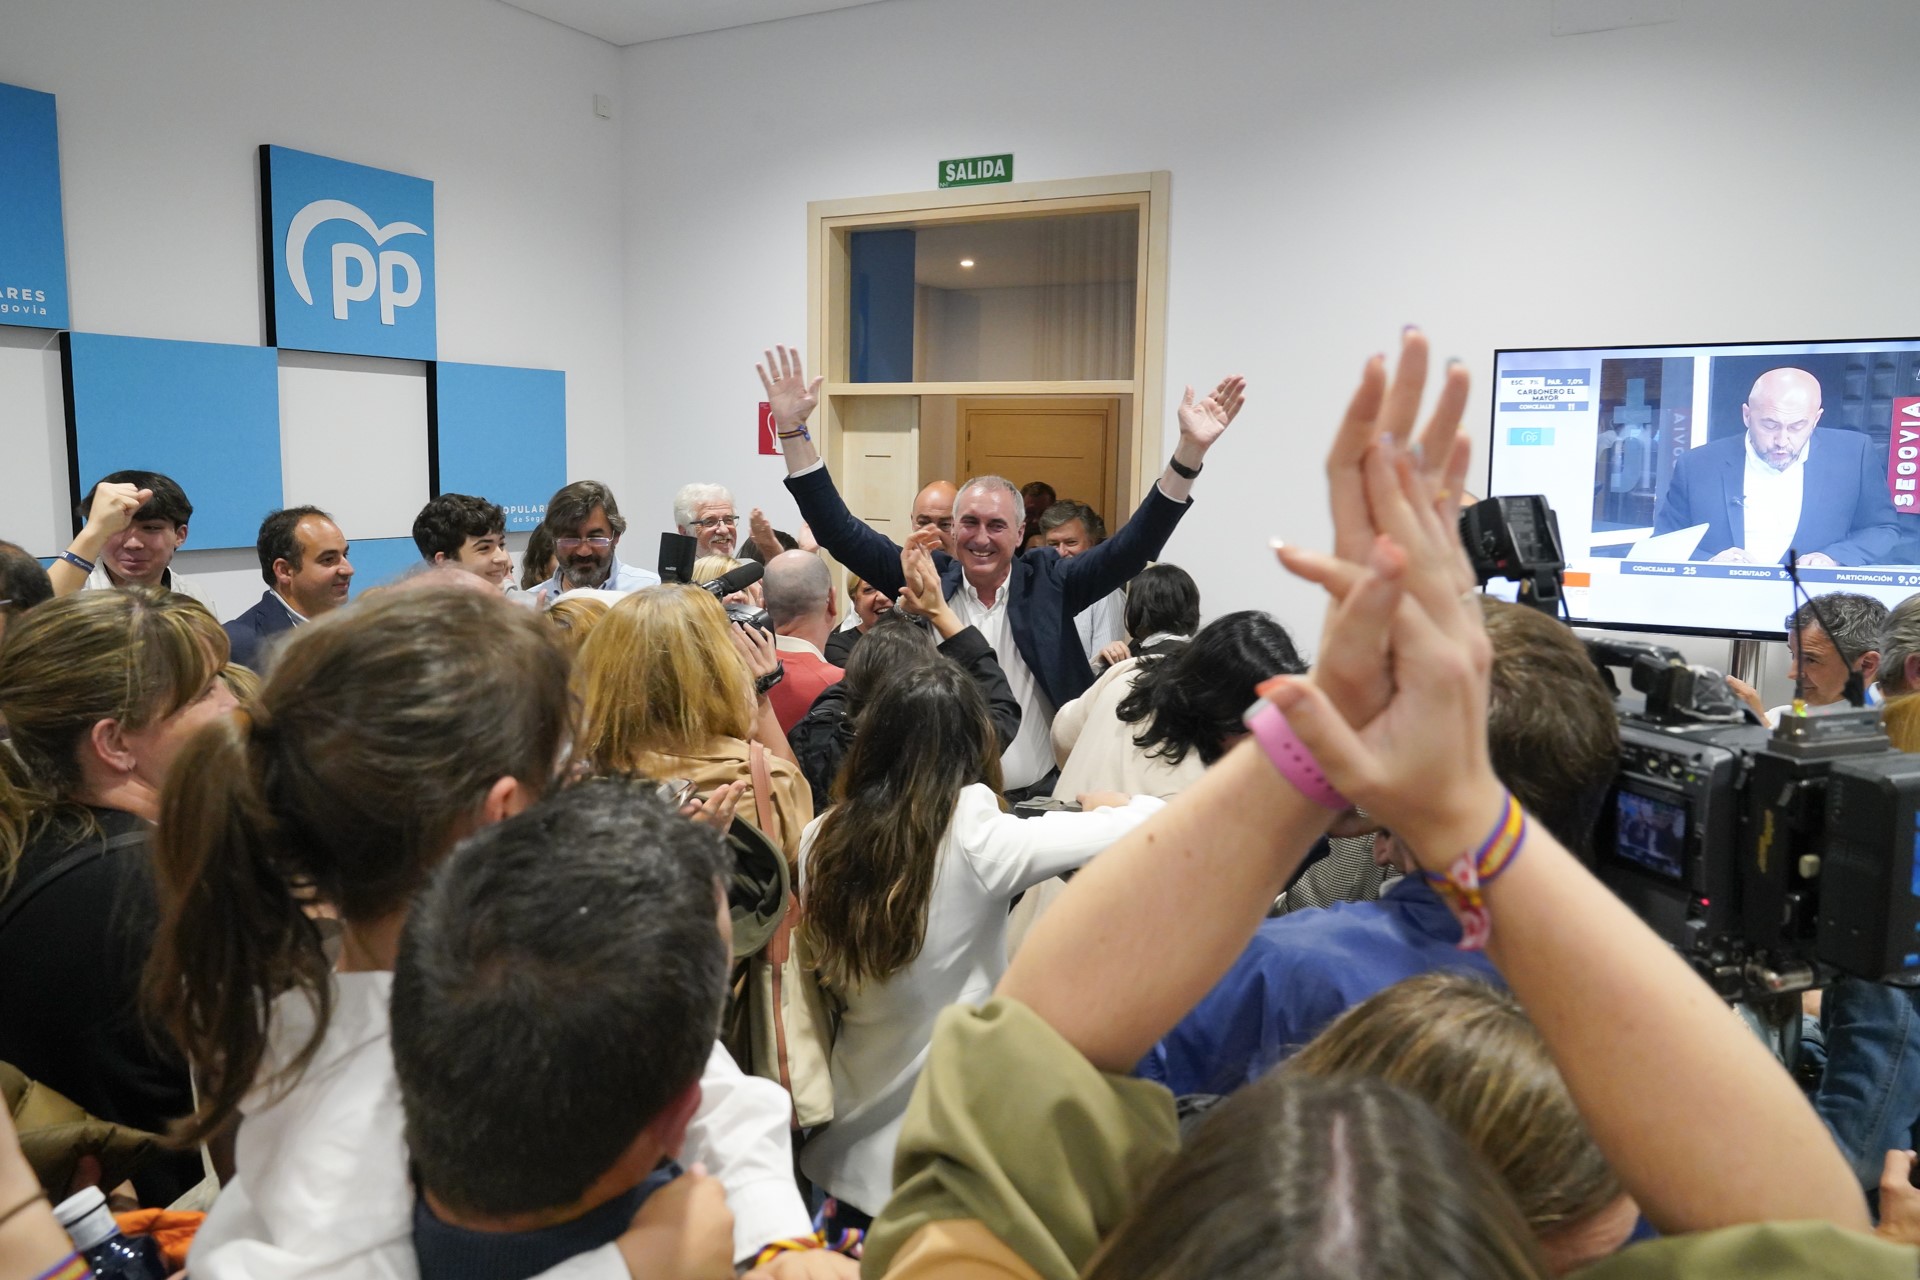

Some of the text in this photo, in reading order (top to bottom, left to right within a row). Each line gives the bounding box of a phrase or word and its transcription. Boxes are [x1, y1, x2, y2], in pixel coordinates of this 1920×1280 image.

[945, 158, 1006, 182] SALIDA
[0, 304, 47, 315] govia
[1893, 402, 1920, 507] SEGOVIA
[502, 504, 548, 515] OPULAR
[1632, 565, 1697, 575] CONCEJALES 25
[1729, 569, 1772, 578] ESCRUTADO
[1836, 573, 1893, 583] PARTICIPACIÓN
